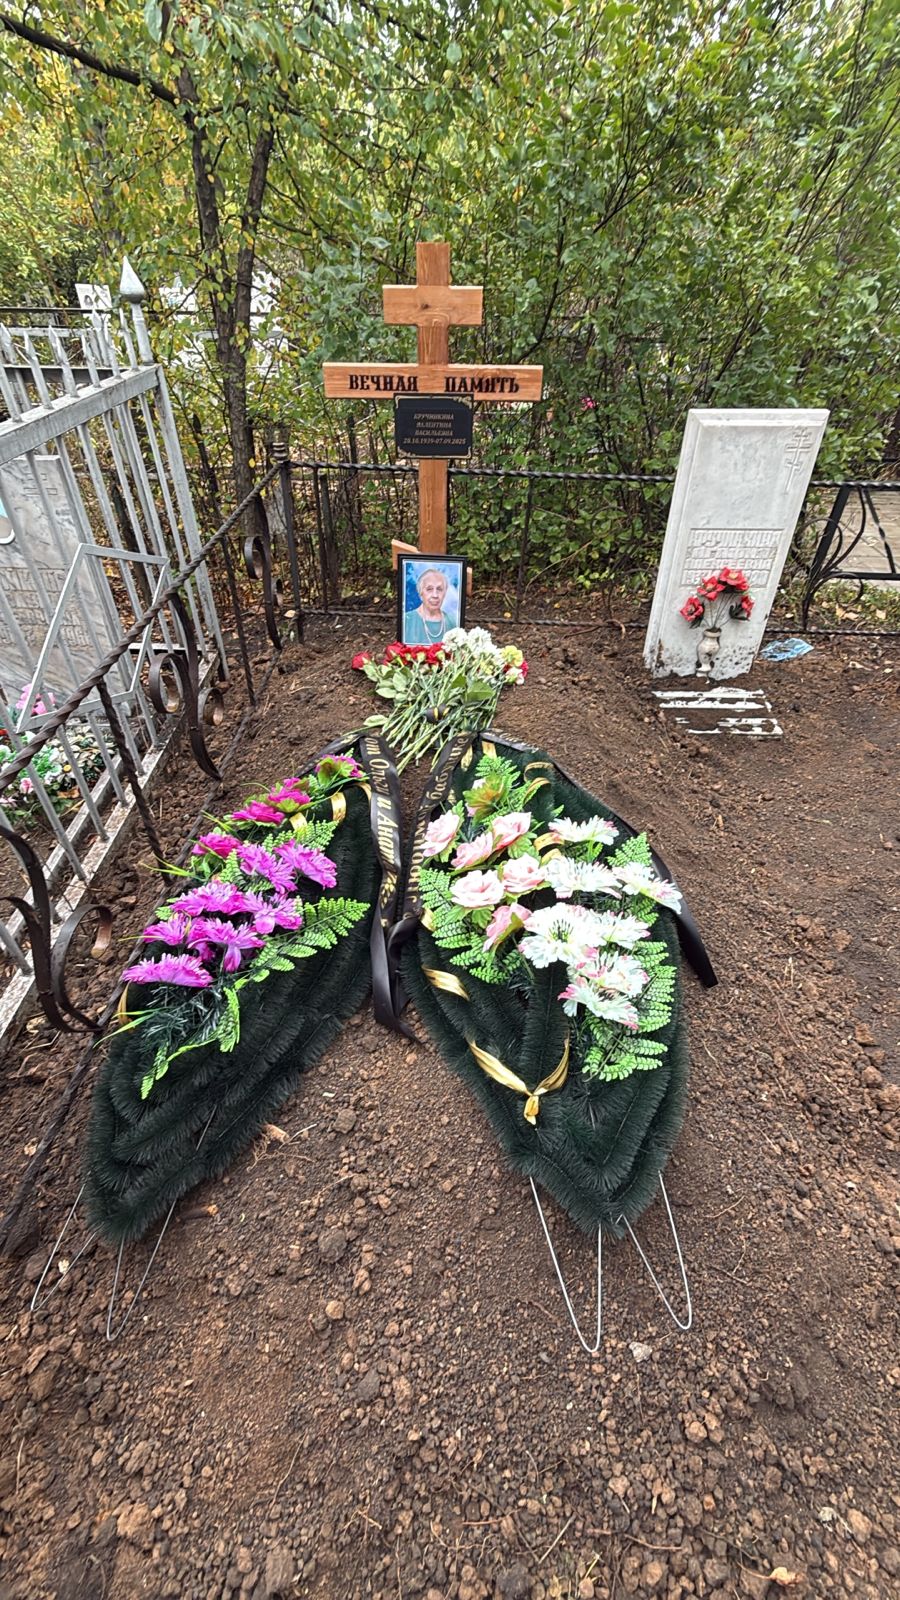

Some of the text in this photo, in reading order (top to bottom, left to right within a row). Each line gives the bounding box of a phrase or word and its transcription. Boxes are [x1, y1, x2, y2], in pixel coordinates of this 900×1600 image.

[348, 374, 520, 394] ВЕЧНАЯ ПАМЯТЬ
[416, 421, 452, 429] ВАЛЕНТИНА
[415, 429, 453, 437] ВАСИЛЬЕВНА
[369, 758, 391, 796] Ольги
